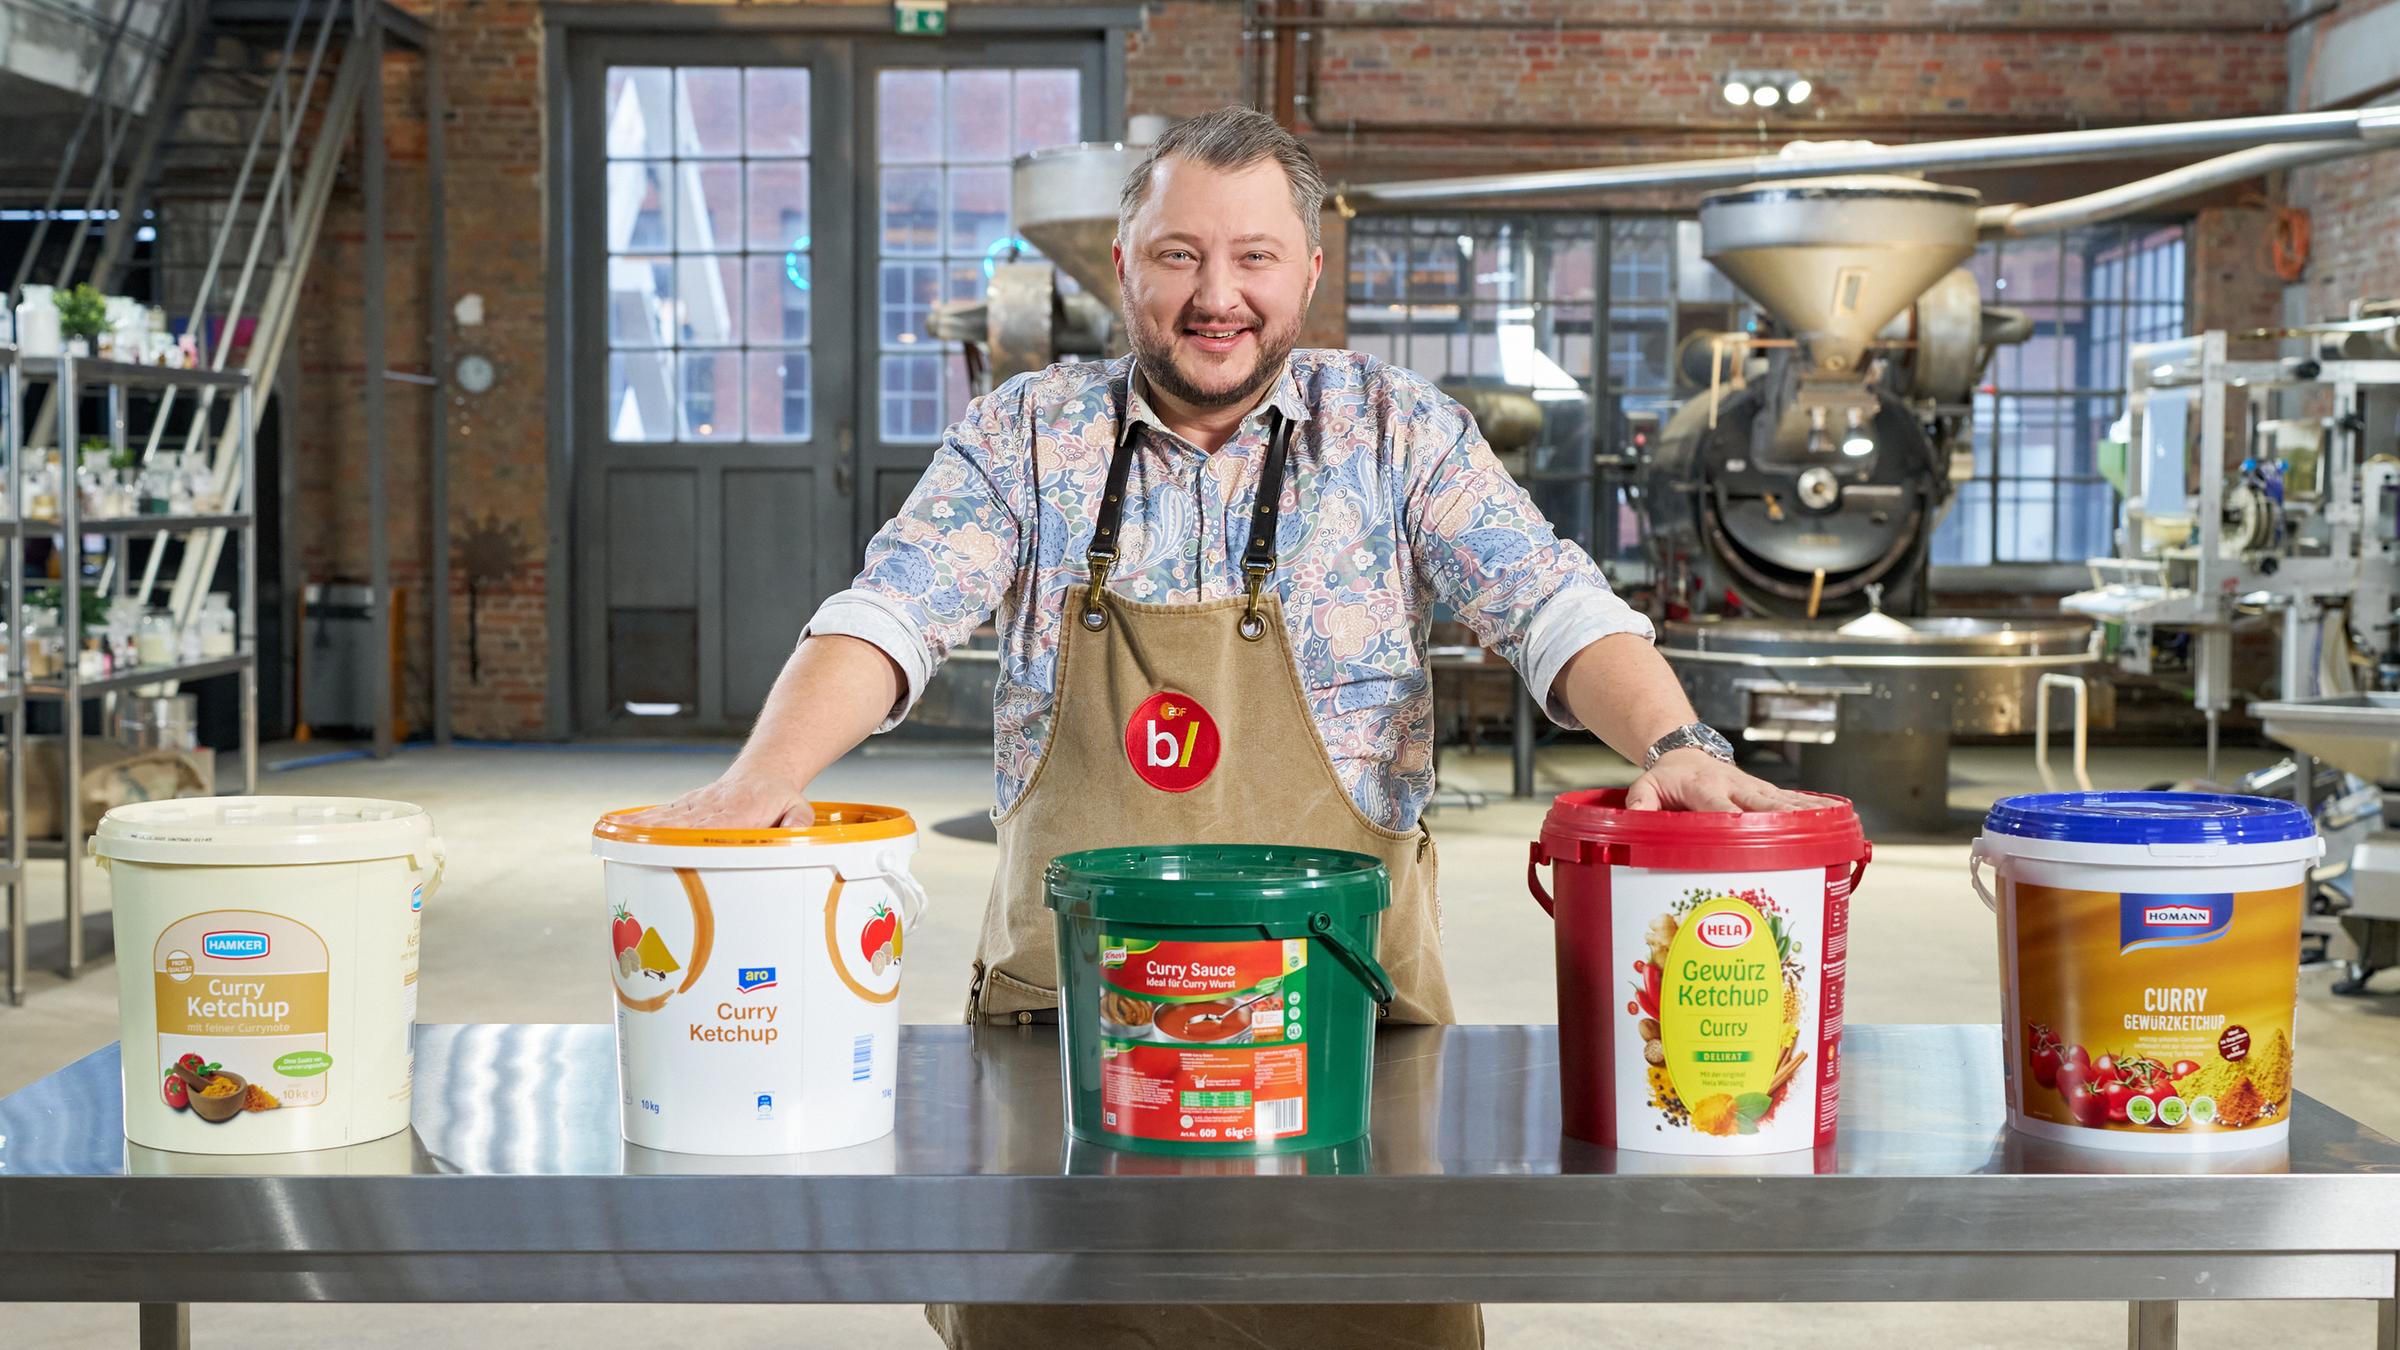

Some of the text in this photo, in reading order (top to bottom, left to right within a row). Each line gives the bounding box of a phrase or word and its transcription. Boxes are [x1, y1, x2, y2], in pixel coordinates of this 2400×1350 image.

[1707, 925, 1742, 935] HELA
[209, 940, 262, 950] HAMKER
[745, 971, 768, 981] aro
[1147, 960, 1236, 979] Curry Sauce
[1683, 958, 1765, 981] Gewürz
[208, 979, 265, 999] Curry
[1168, 978, 1180, 988] für
[1182, 980, 1207, 990] Curry
[1209, 980, 1236, 988] Wurst
[1679, 985, 1769, 1006] Ketchup
[2144, 987, 2208, 1012] CURRY
[187, 996, 289, 1022] Ketchup
[717, 1002, 778, 1023] Curry
[187, 1023, 290, 1034] mit feiner Currynote
[1699, 1018, 1748, 1037] Curry
[2124, 1014, 2226, 1031] GEWÜRZKETCHUP
[690, 1023, 778, 1045] Ketchup
[1703, 1052, 1742, 1060] DELIKAT
[1199, 1128, 1217, 1137] 609
